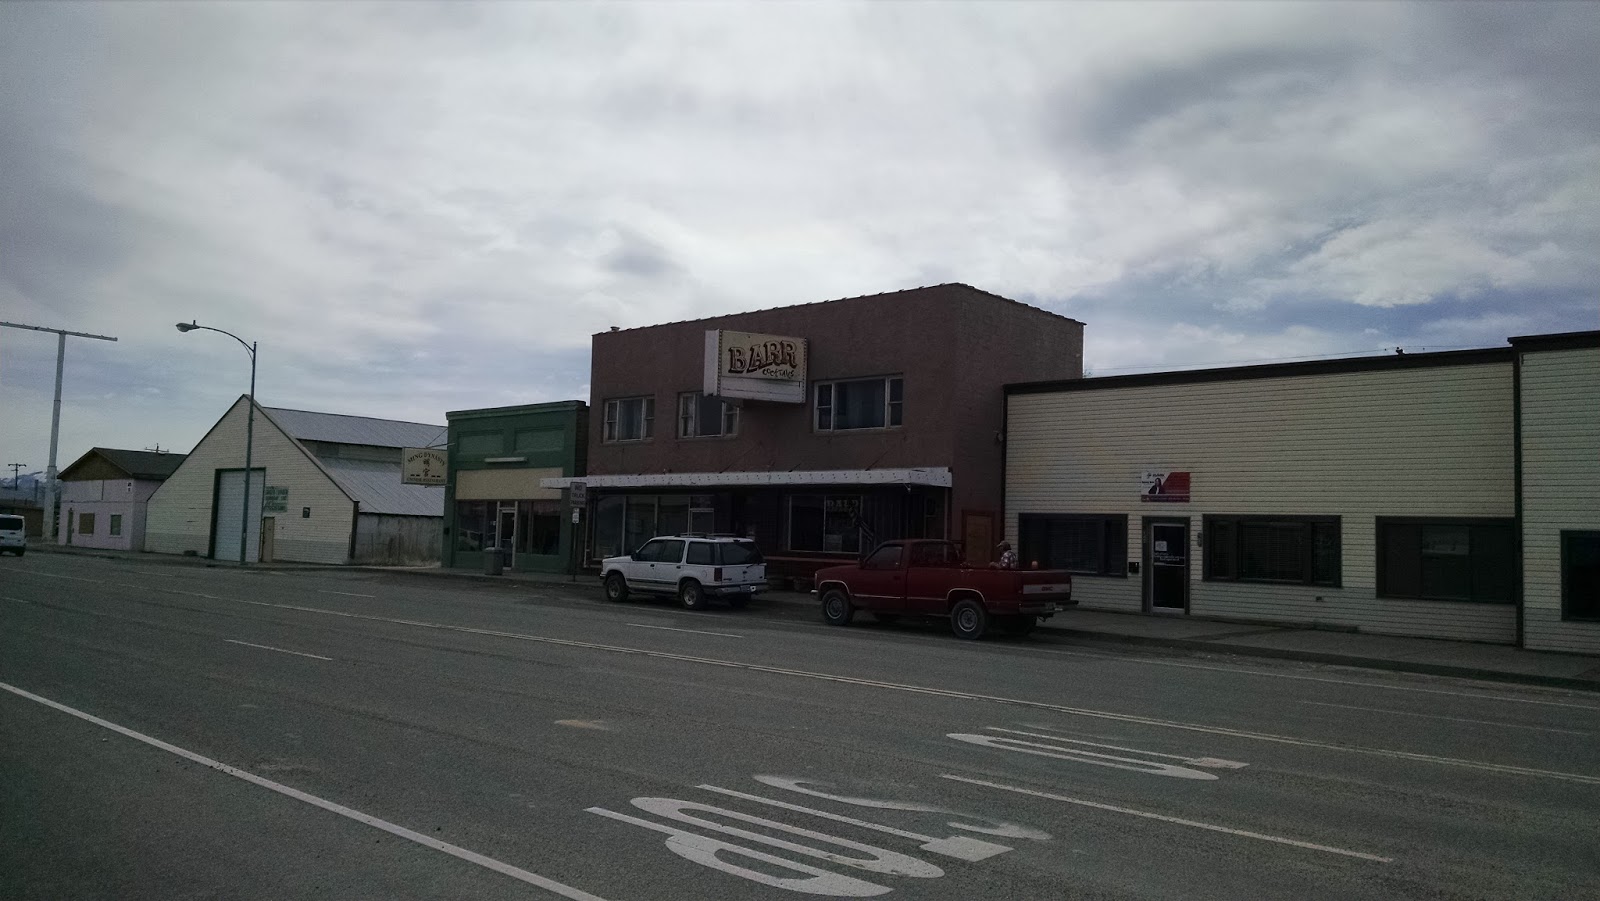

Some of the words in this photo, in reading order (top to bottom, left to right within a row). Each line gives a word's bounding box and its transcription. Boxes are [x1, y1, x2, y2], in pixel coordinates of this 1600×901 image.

[728, 340, 798, 374] BARR
[407, 452, 422, 462] MING
[424, 452, 445, 465] DYNASTY
